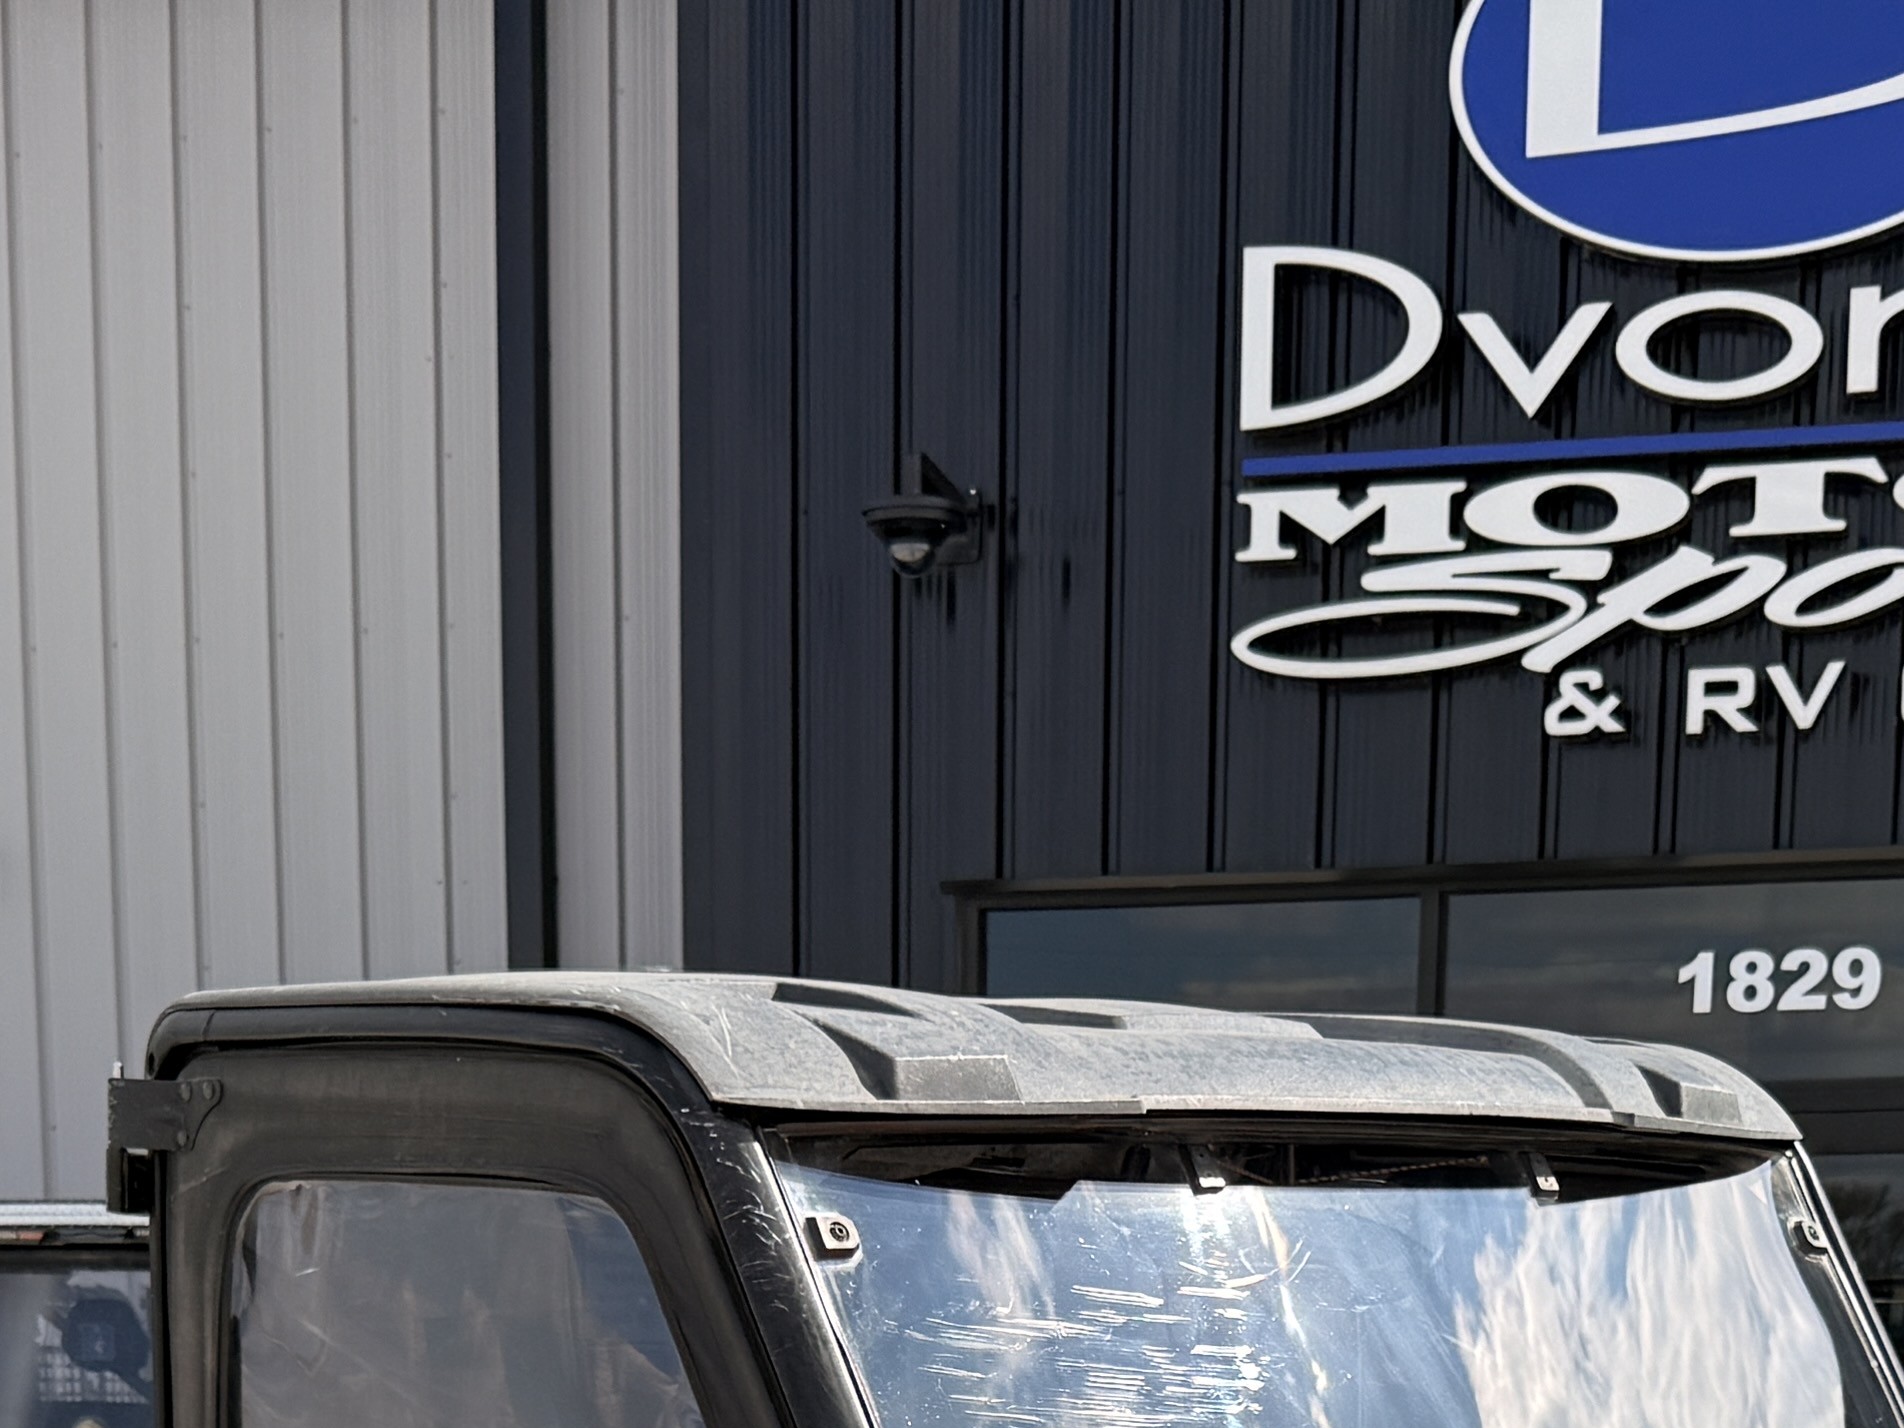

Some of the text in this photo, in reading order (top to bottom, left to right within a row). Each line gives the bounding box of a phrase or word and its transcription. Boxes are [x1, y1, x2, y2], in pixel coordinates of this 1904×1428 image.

[1544, 668, 1625, 737] &
[1685, 661, 1846, 735] RV
[1677, 946, 1882, 1014] 1829
